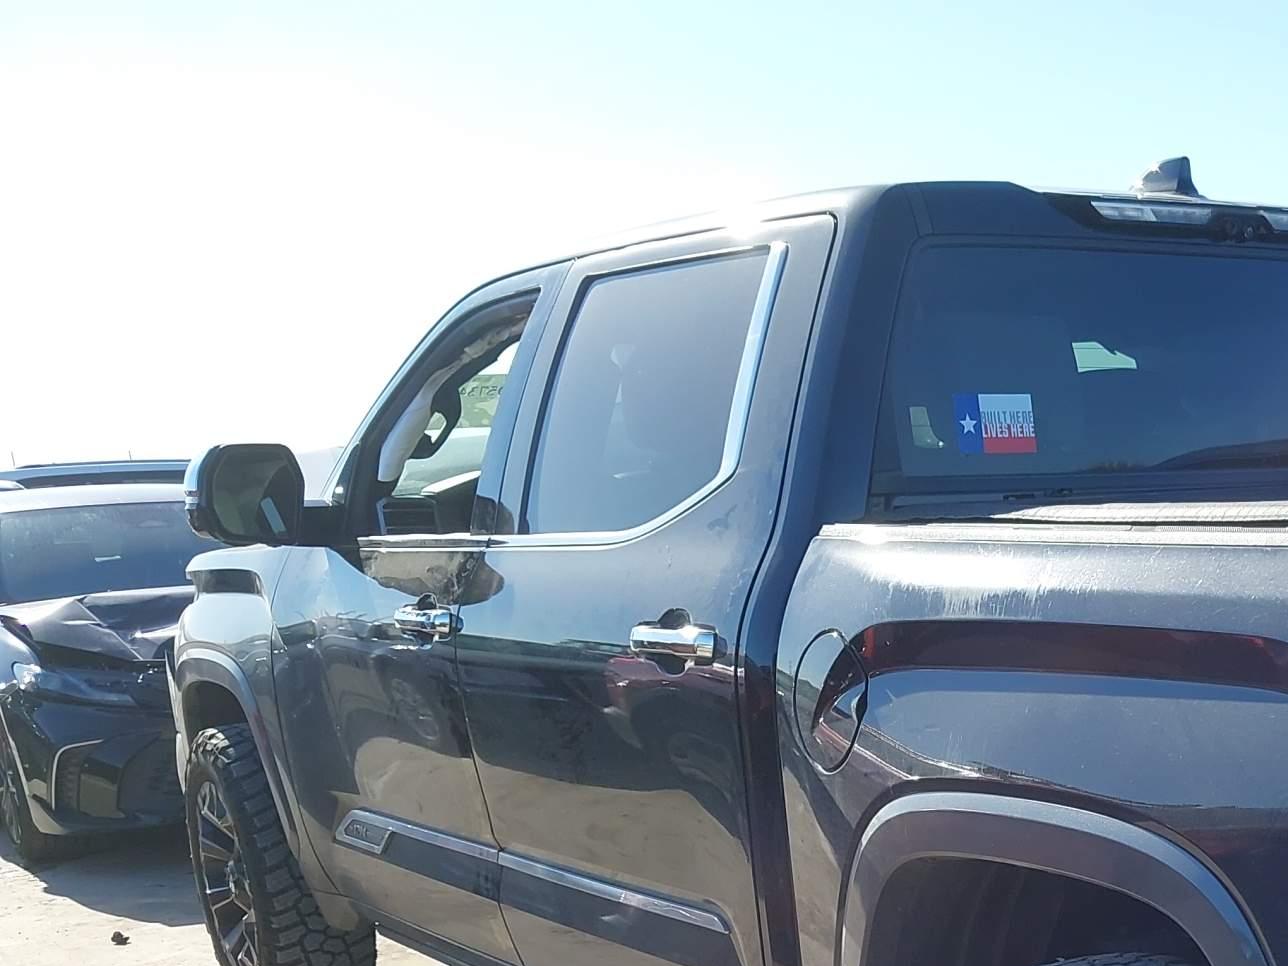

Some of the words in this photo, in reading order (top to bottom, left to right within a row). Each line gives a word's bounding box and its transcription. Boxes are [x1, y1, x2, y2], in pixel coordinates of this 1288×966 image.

[980, 410, 1006, 425] BUILT
[1010, 410, 1033, 424] HERE
[982, 423, 1008, 438] LIVES
[1012, 423, 1035, 437] HERE
